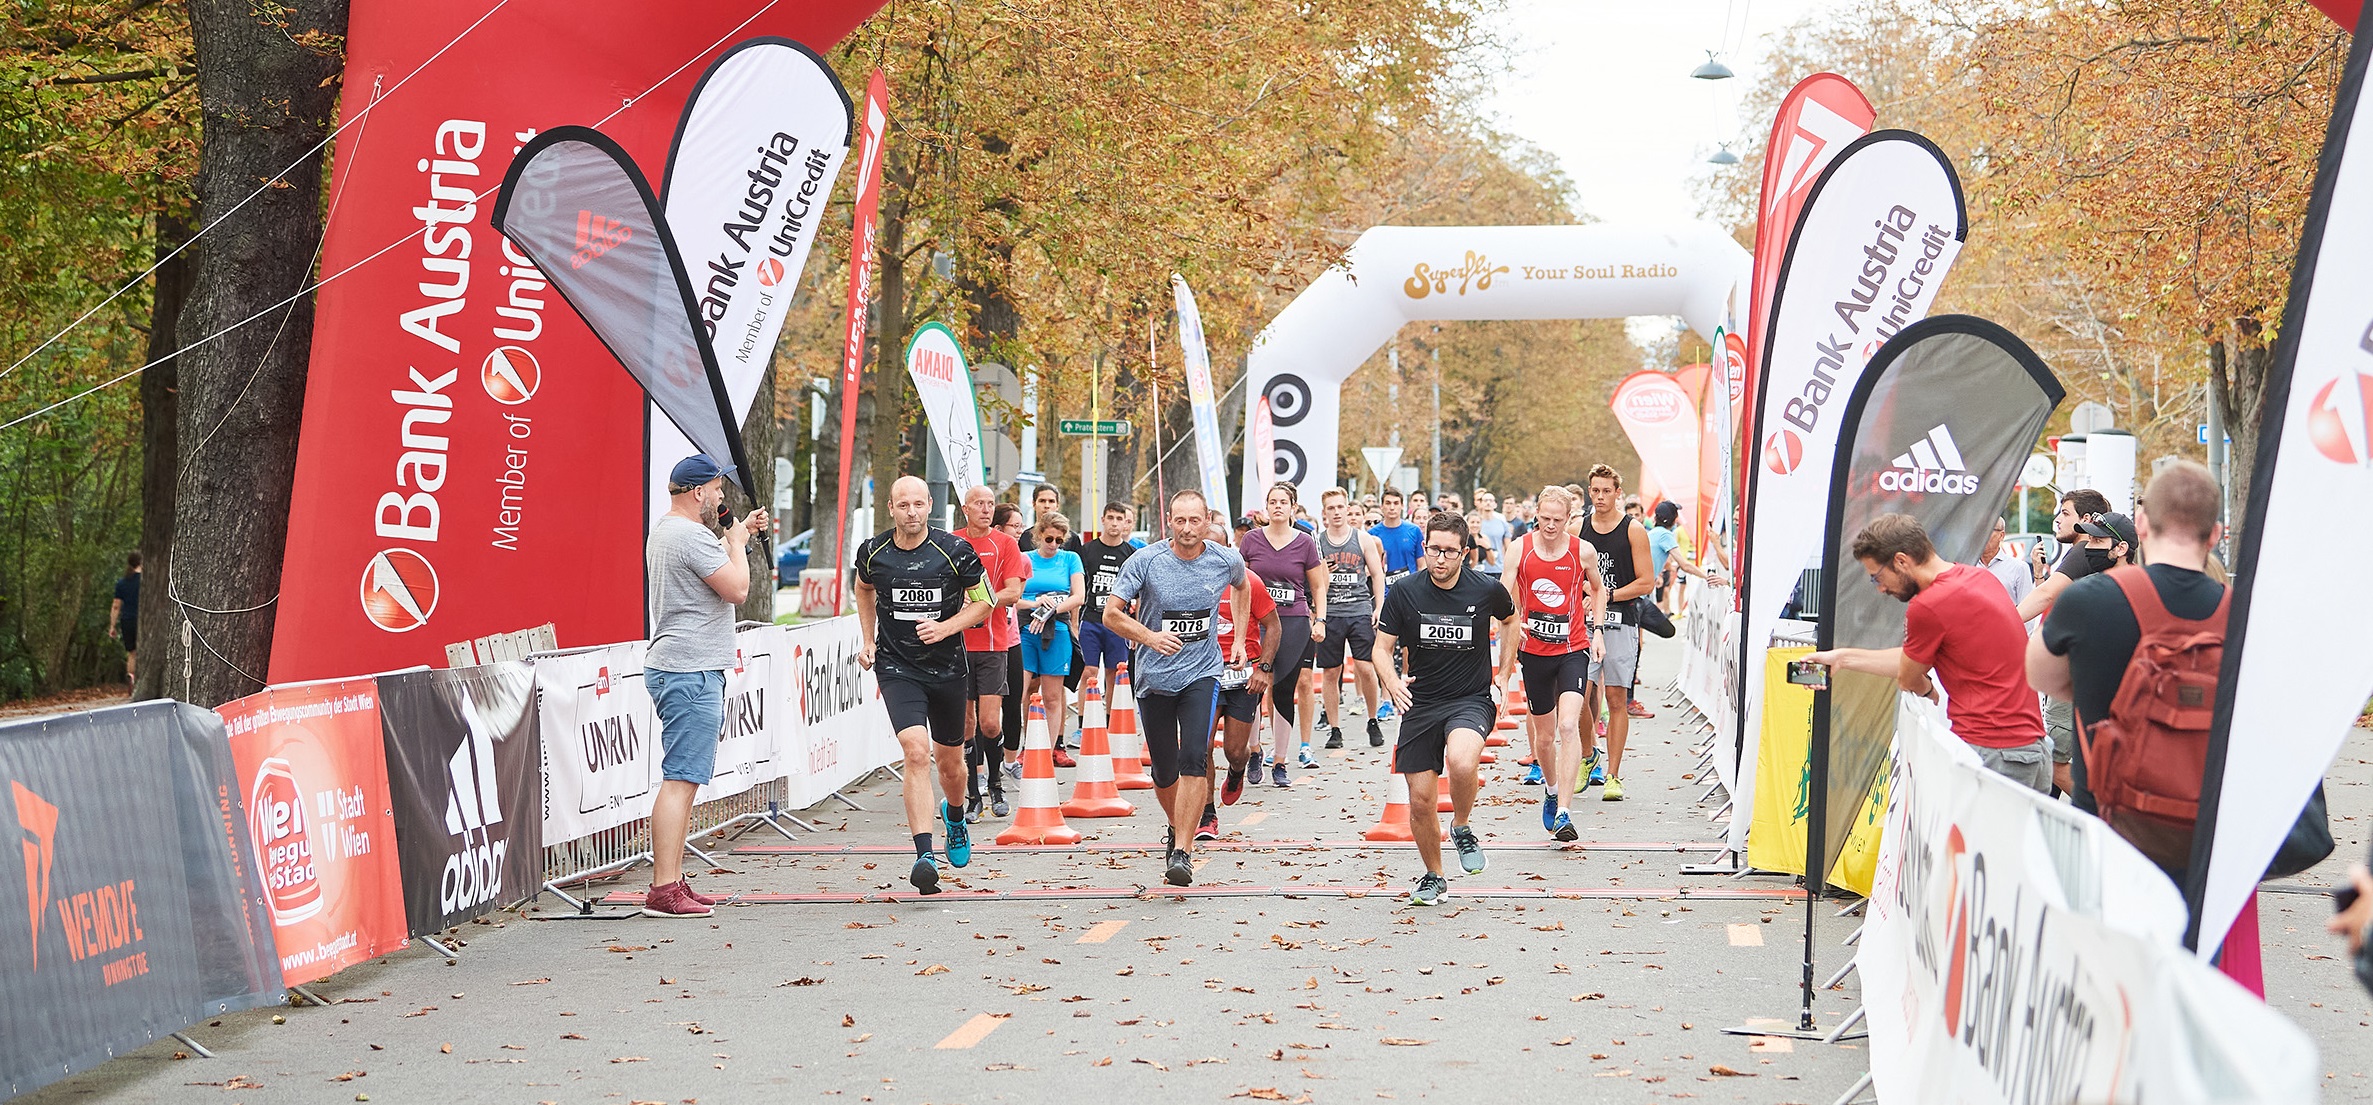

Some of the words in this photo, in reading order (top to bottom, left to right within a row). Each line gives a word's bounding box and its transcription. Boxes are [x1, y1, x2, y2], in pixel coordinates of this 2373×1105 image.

[723, 131, 799, 254] Austria
[400, 119, 487, 355] Austria
[735, 306, 768, 364] Member
[759, 291, 774, 307] of
[768, 148, 832, 258] UniCredit
[1403, 250, 1510, 300] Superfly
[1521, 265, 1568, 281] Your
[1573, 264, 1616, 280] Soul
[1621, 263, 1679, 279] Radio
[1782, 332, 1853, 434] Bank
[1834, 203, 1918, 335] Austria
[509, 412, 532, 439] of
[1074, 423, 1115, 432] Pratestern
[374, 366, 459, 543] Bank
[1878, 467, 1980, 495] adidas
[492, 444, 528, 551] Member
[1598, 559, 1615, 568] ORE
[1333, 574, 1352, 582] 2041
[900, 590, 934, 602] 2080
[1170, 620, 1203, 633] 2078
[1428, 626, 1464, 640] 2050
[1534, 620, 1562, 634] 2101
[805, 644, 834, 727] Bank
[358, 693, 374, 711] Wien
[336, 785, 366, 821] Stadt
[340, 824, 371, 859] Wien
